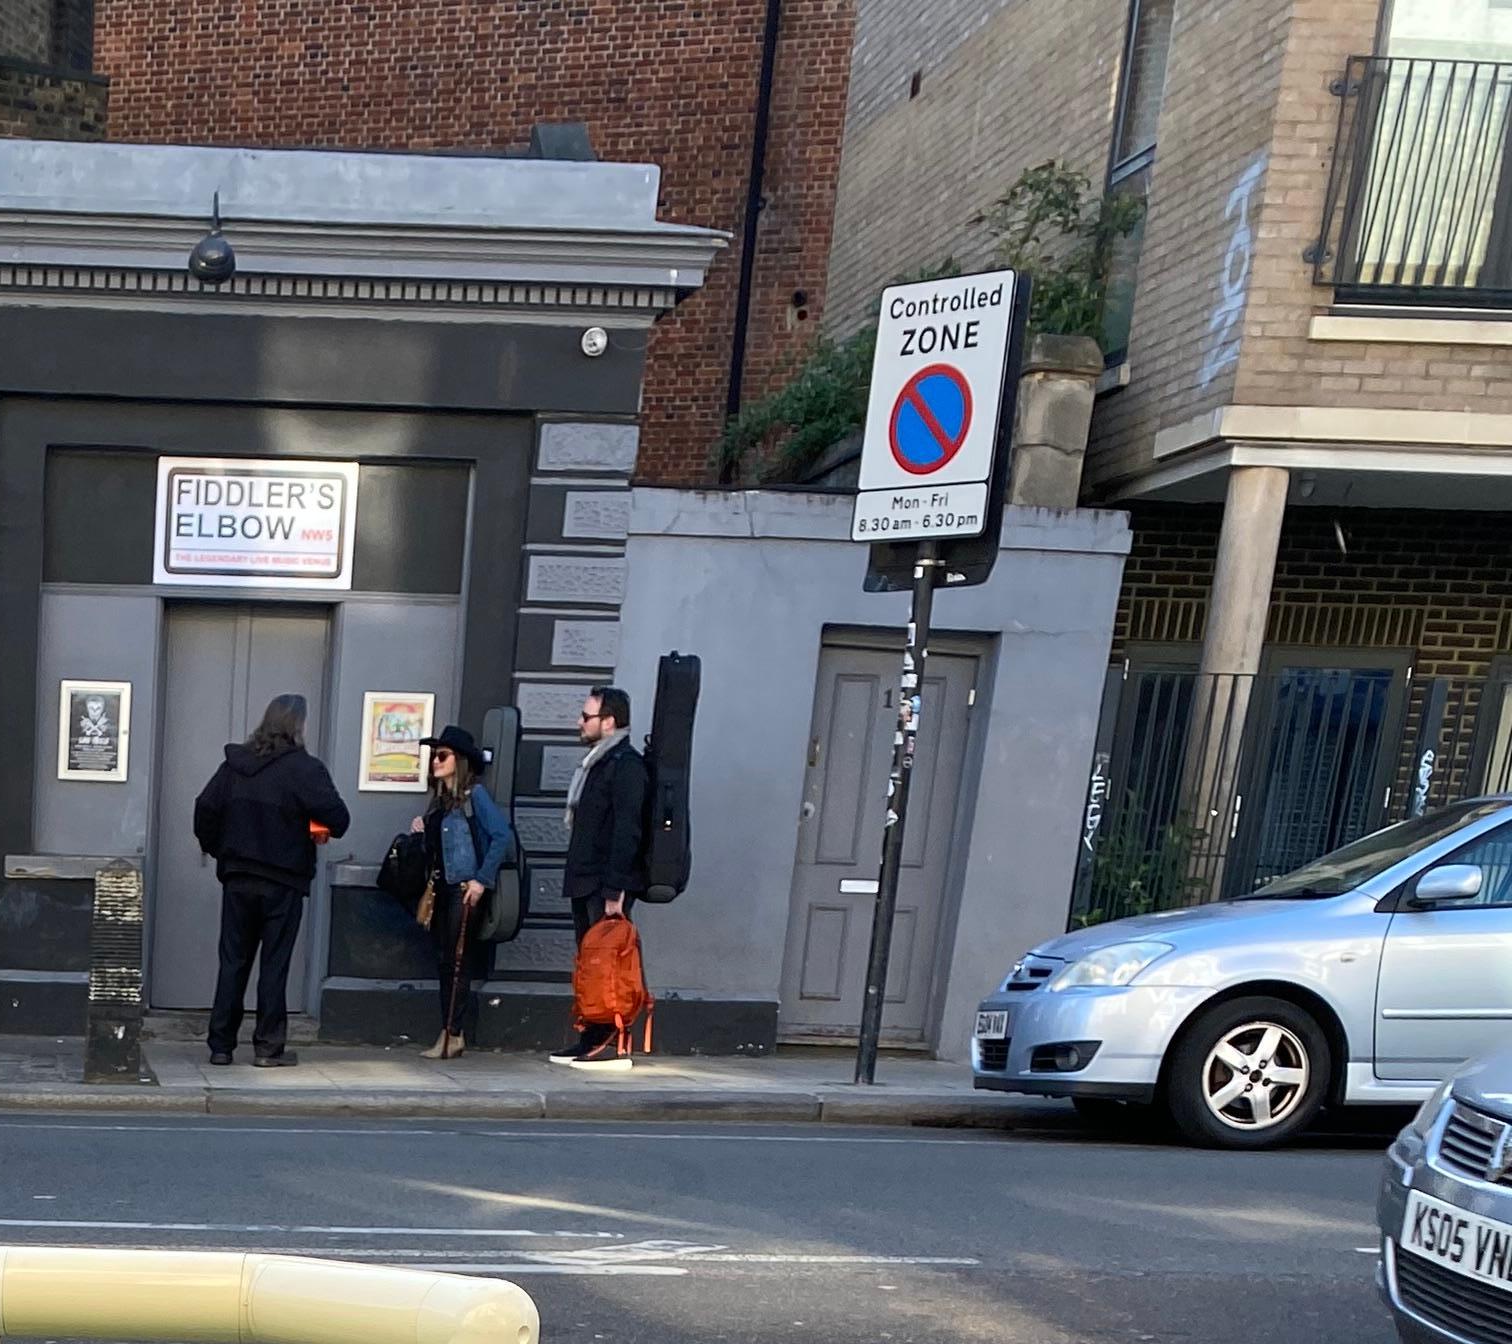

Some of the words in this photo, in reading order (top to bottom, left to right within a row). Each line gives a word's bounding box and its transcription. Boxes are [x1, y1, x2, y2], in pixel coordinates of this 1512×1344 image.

[890, 283, 1003, 319] Controlled
[900, 320, 980, 356] ZONE
[177, 478, 335, 510] FIDDLER'S
[891, 496, 920, 510] Mon
[930, 492, 949, 507] Fri
[176, 512, 296, 540] ELBOW
[300, 529, 333, 542] NW5
[858, 517, 889, 532] 8.30
[892, 519, 912, 530] am
[922, 512, 955, 528] 6.30
[957, 514, 978, 528] pm
[1474, 1225, 1512, 1281] VN
